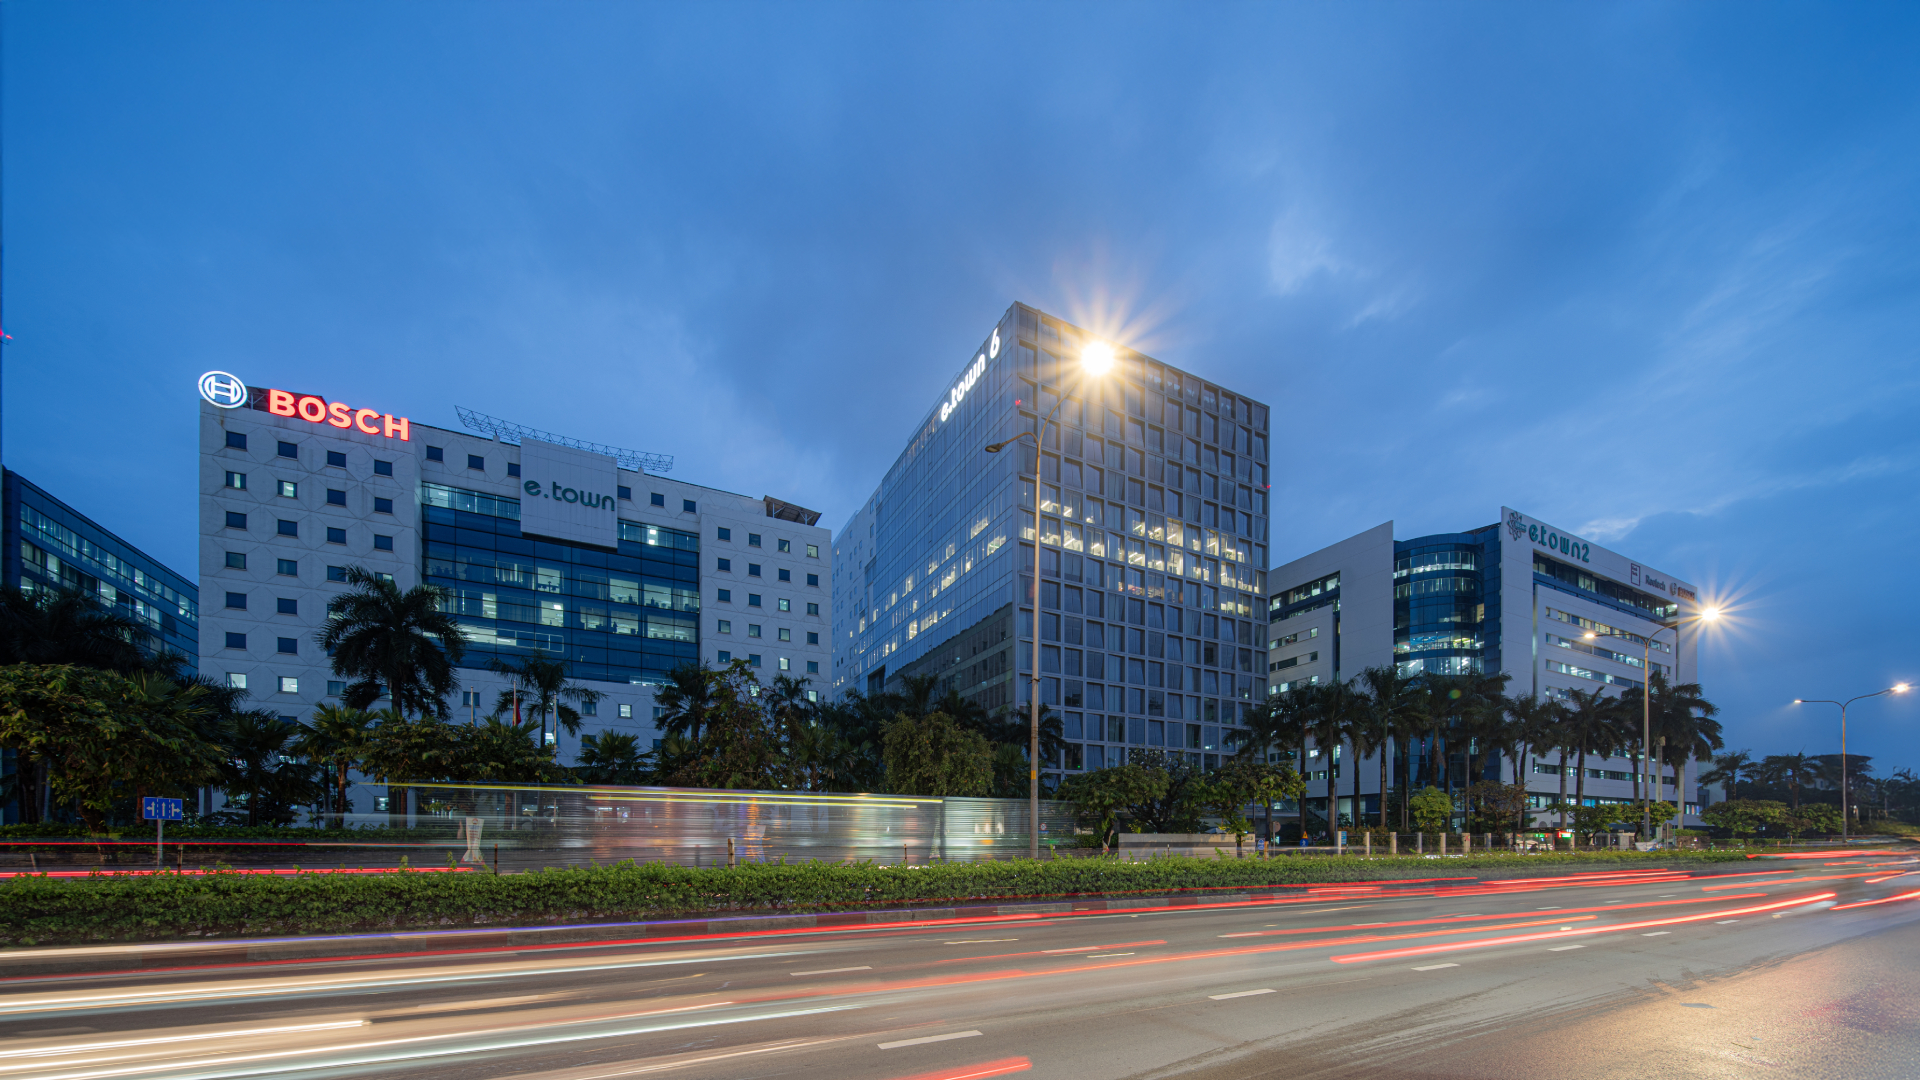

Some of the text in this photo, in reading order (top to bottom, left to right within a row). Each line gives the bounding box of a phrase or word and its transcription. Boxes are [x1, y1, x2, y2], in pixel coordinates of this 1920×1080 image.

[940, 327, 1000, 422] e.town 6
[268, 388, 410, 442] BOSCH
[523, 480, 615, 512] e.town
[1529, 524, 1590, 563] e.town2
